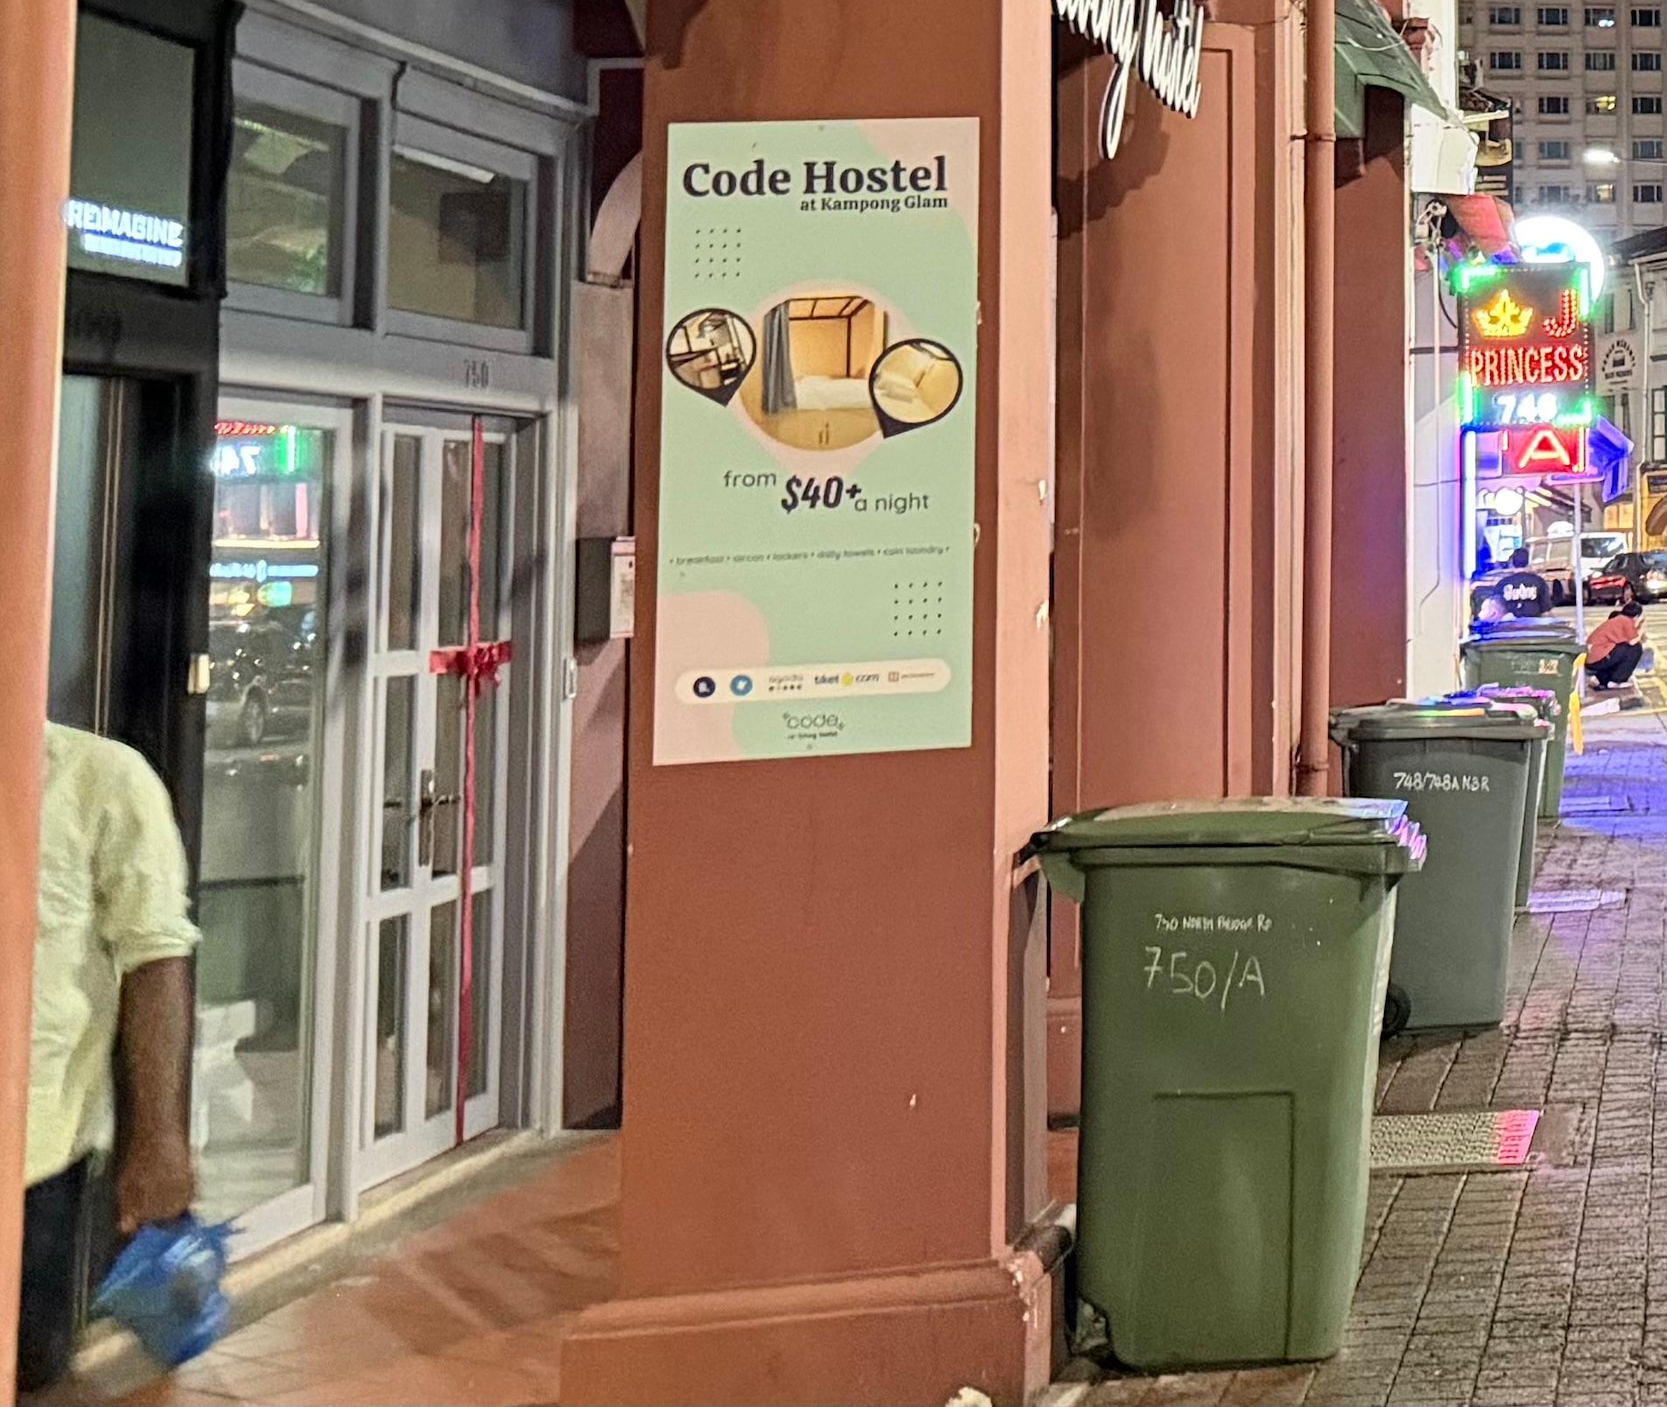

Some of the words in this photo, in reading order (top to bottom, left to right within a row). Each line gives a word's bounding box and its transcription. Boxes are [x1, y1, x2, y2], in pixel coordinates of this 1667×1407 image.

[683, 158, 791, 197] Code
[803, 155, 947, 195] Hostel
[800, 198, 817, 212] at
[821, 197, 901, 214] Kampong
[904, 195, 949, 210] Glam
[1543, 288, 1580, 337] J
[1471, 345, 1584, 387] PRINCESS
[723, 470, 777, 488] from
[781, 474, 862, 515] $40+
[854, 498, 868, 512] a
[875, 492, 930, 515] night
[786, 713, 839, 730] code
[1143, 946, 1266, 1012] 750/A
